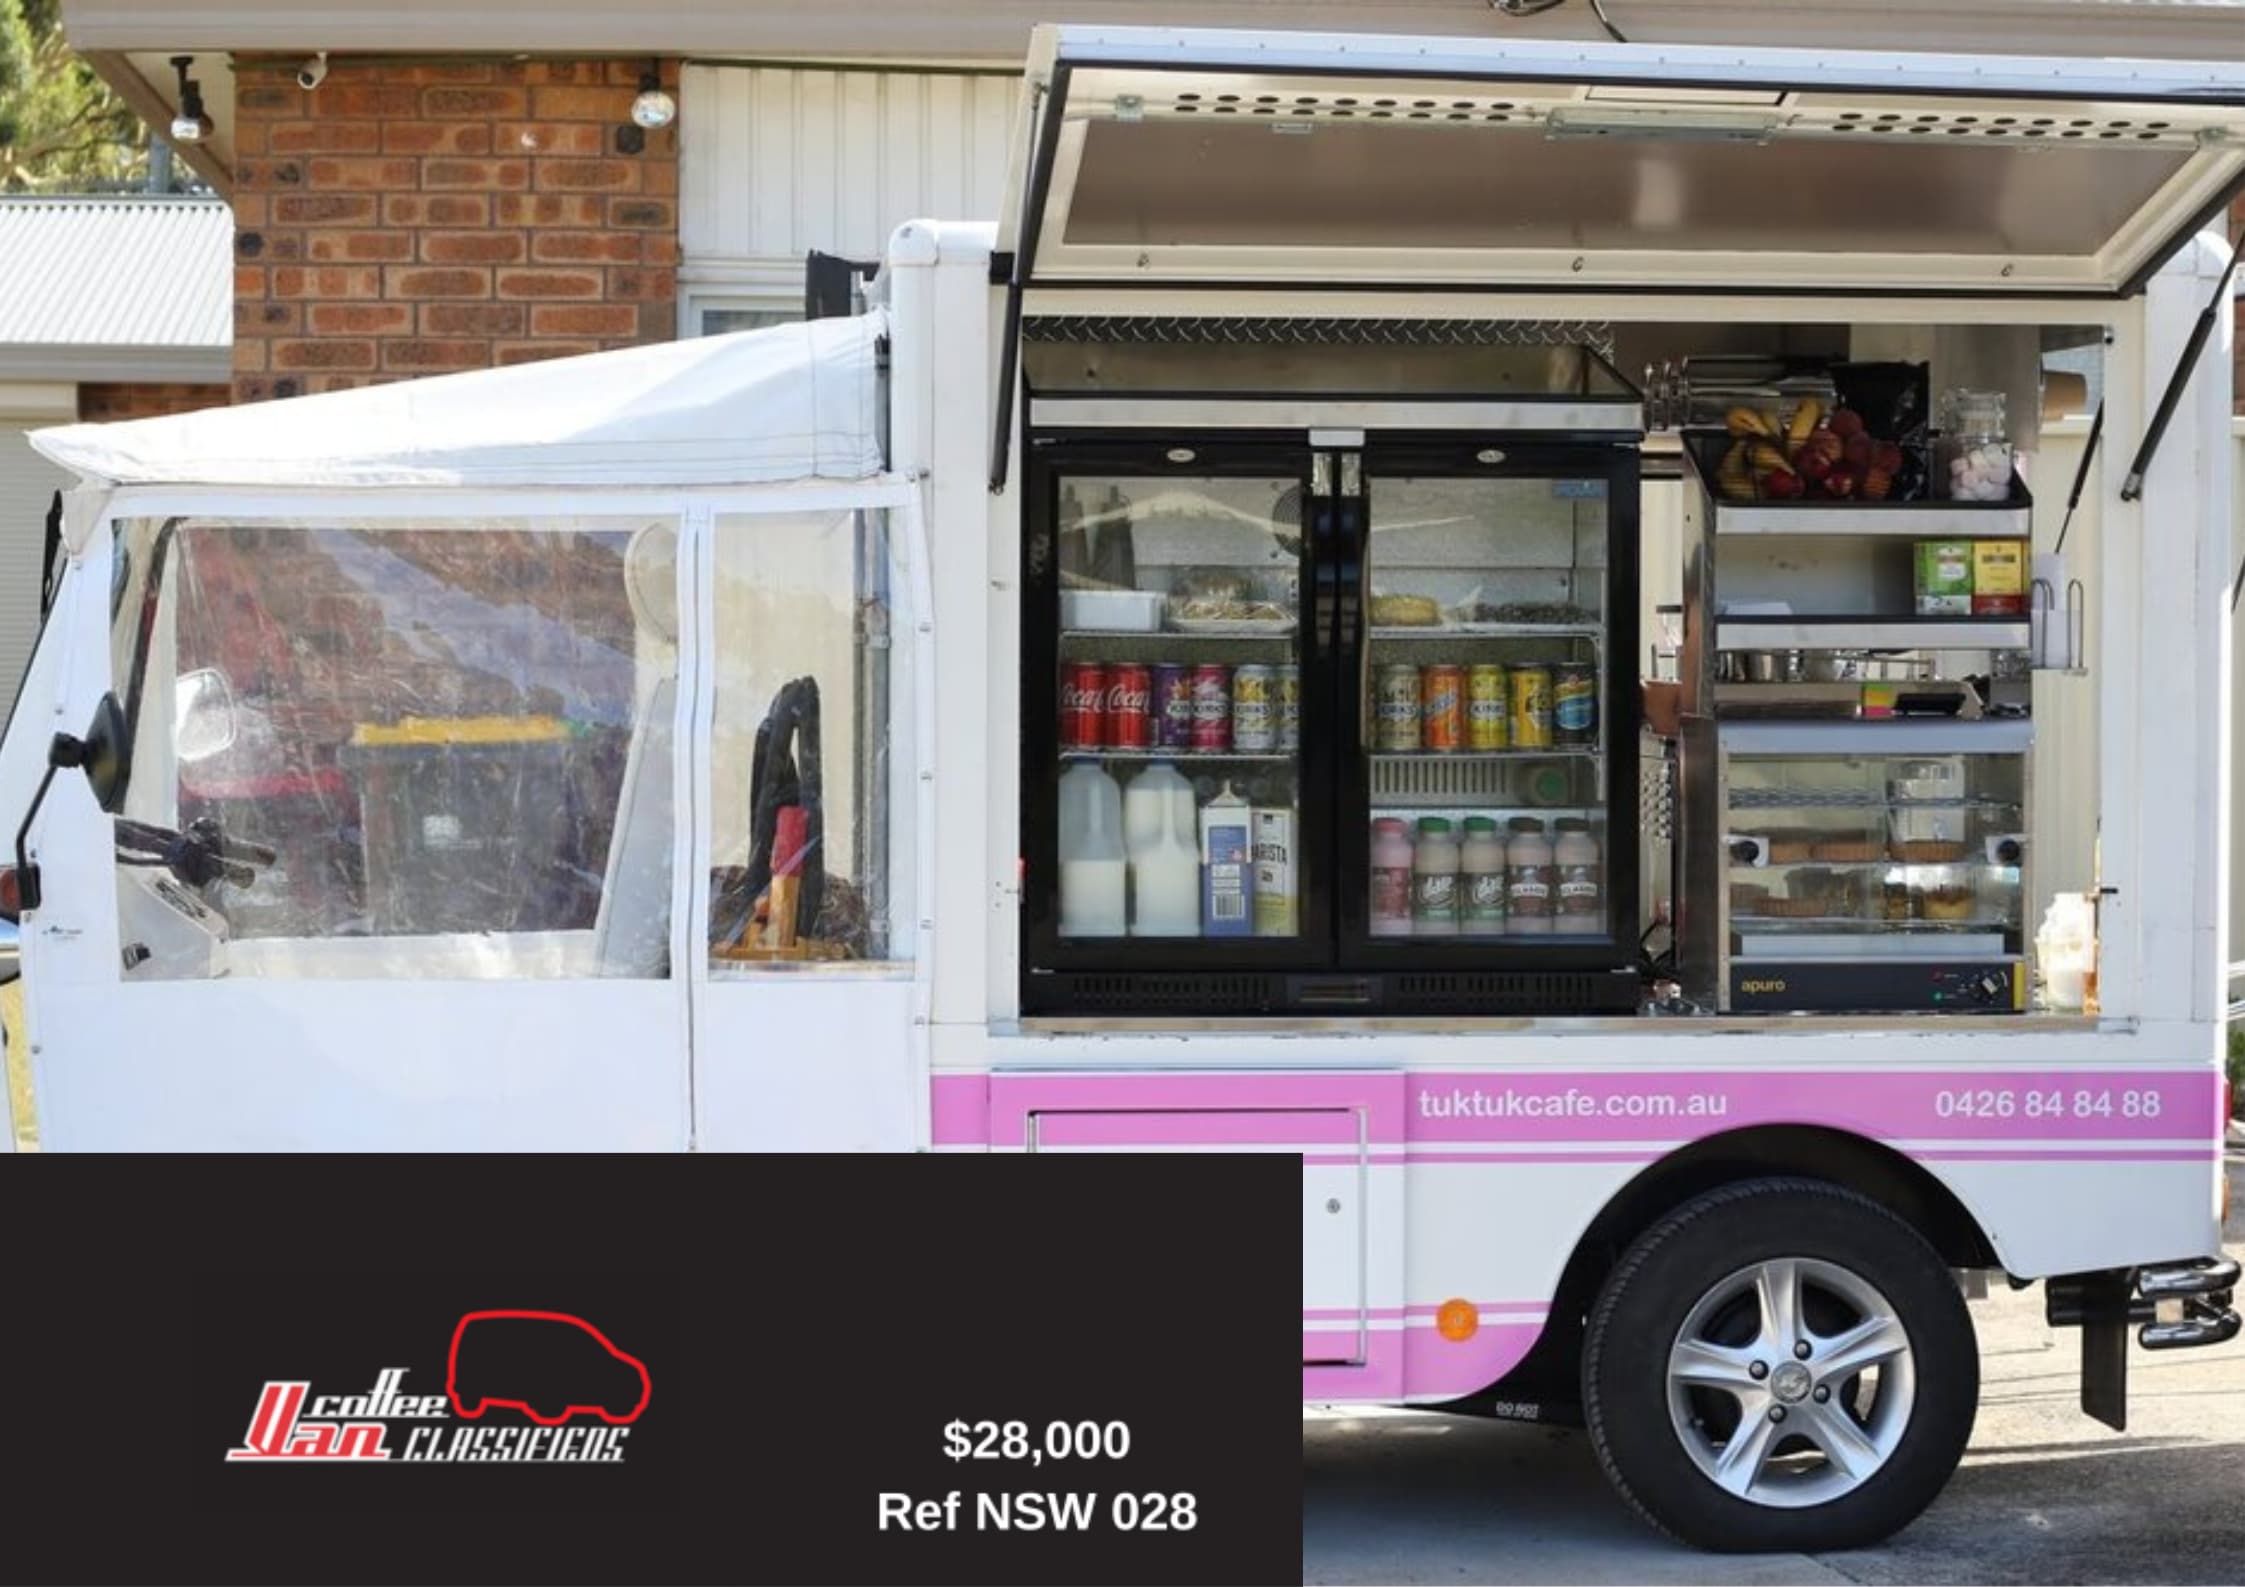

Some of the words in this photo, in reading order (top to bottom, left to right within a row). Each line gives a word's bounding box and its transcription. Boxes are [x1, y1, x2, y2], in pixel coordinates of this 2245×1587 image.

[1107, 683, 1149, 713] Coca
[1741, 980, 1786, 994] apuro
[1420, 1089, 1726, 1117] tuktukcafe.com.au
[1935, 1090, 2016, 1118] 0426
[2024, 1090, 2065, 1118] 84
[2073, 1090, 2113, 1118] 84
[2122, 1090, 2161, 1118] 88
